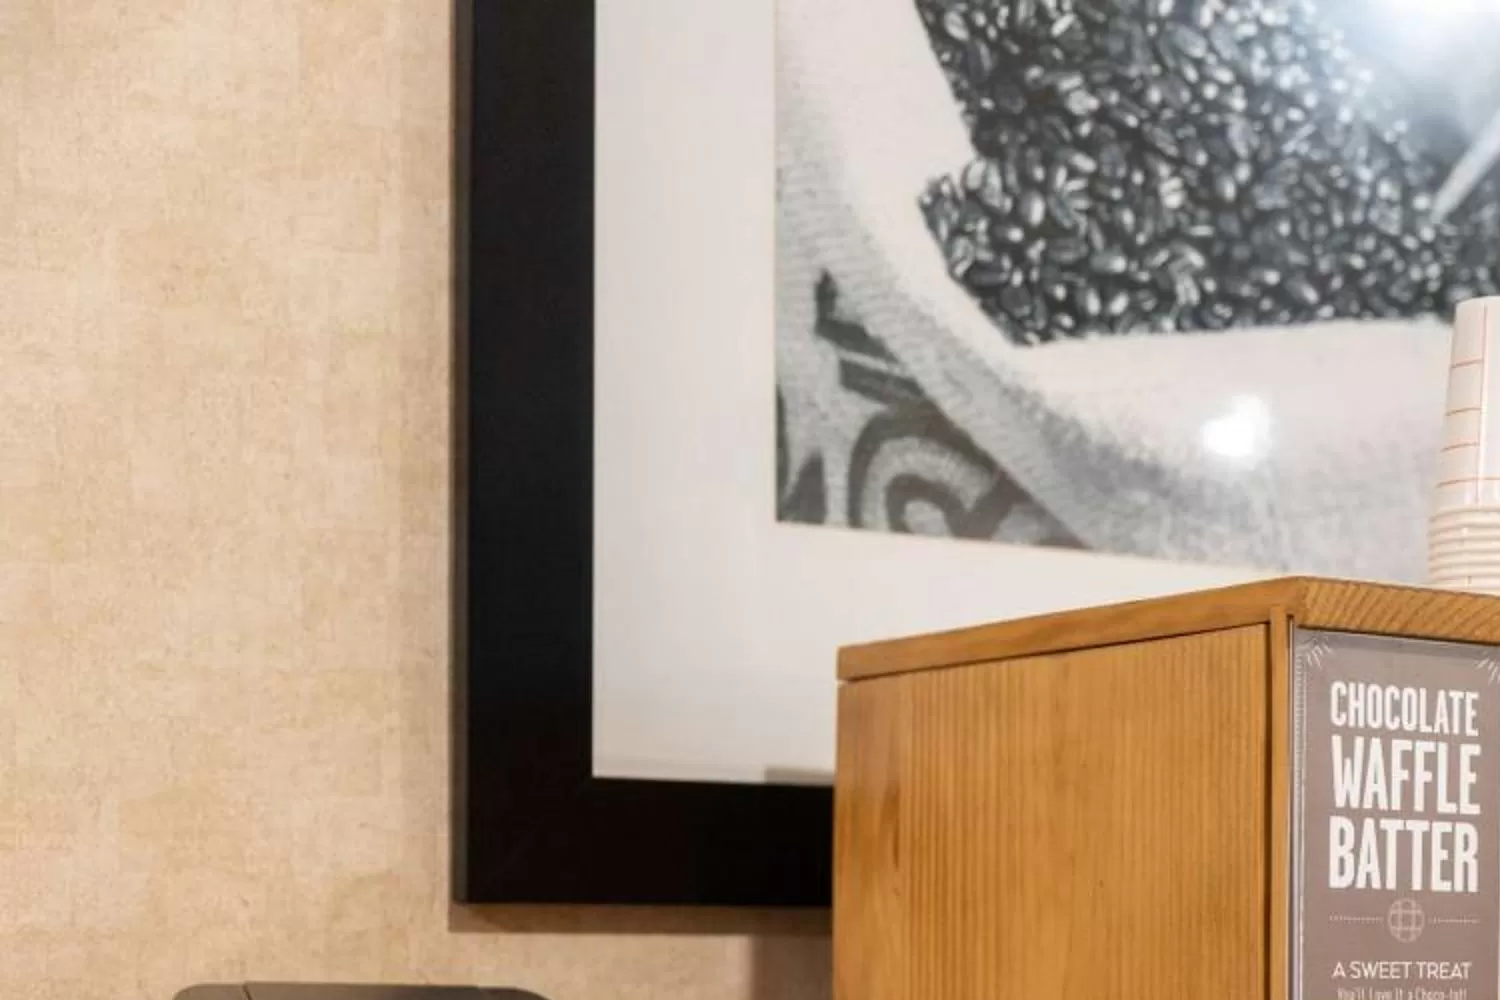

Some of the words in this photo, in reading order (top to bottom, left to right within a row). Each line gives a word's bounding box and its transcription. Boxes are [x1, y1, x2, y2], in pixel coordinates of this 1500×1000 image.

[1329, 680, 1480, 737] CHOCOLATE
[1331, 734, 1481, 815] WAFFLE
[1328, 815, 1480, 893] BATTER
[1332, 961, 1346, 979] A
[1349, 961, 1413, 979] SWEET
[1415, 961, 1473, 980] TREAT
